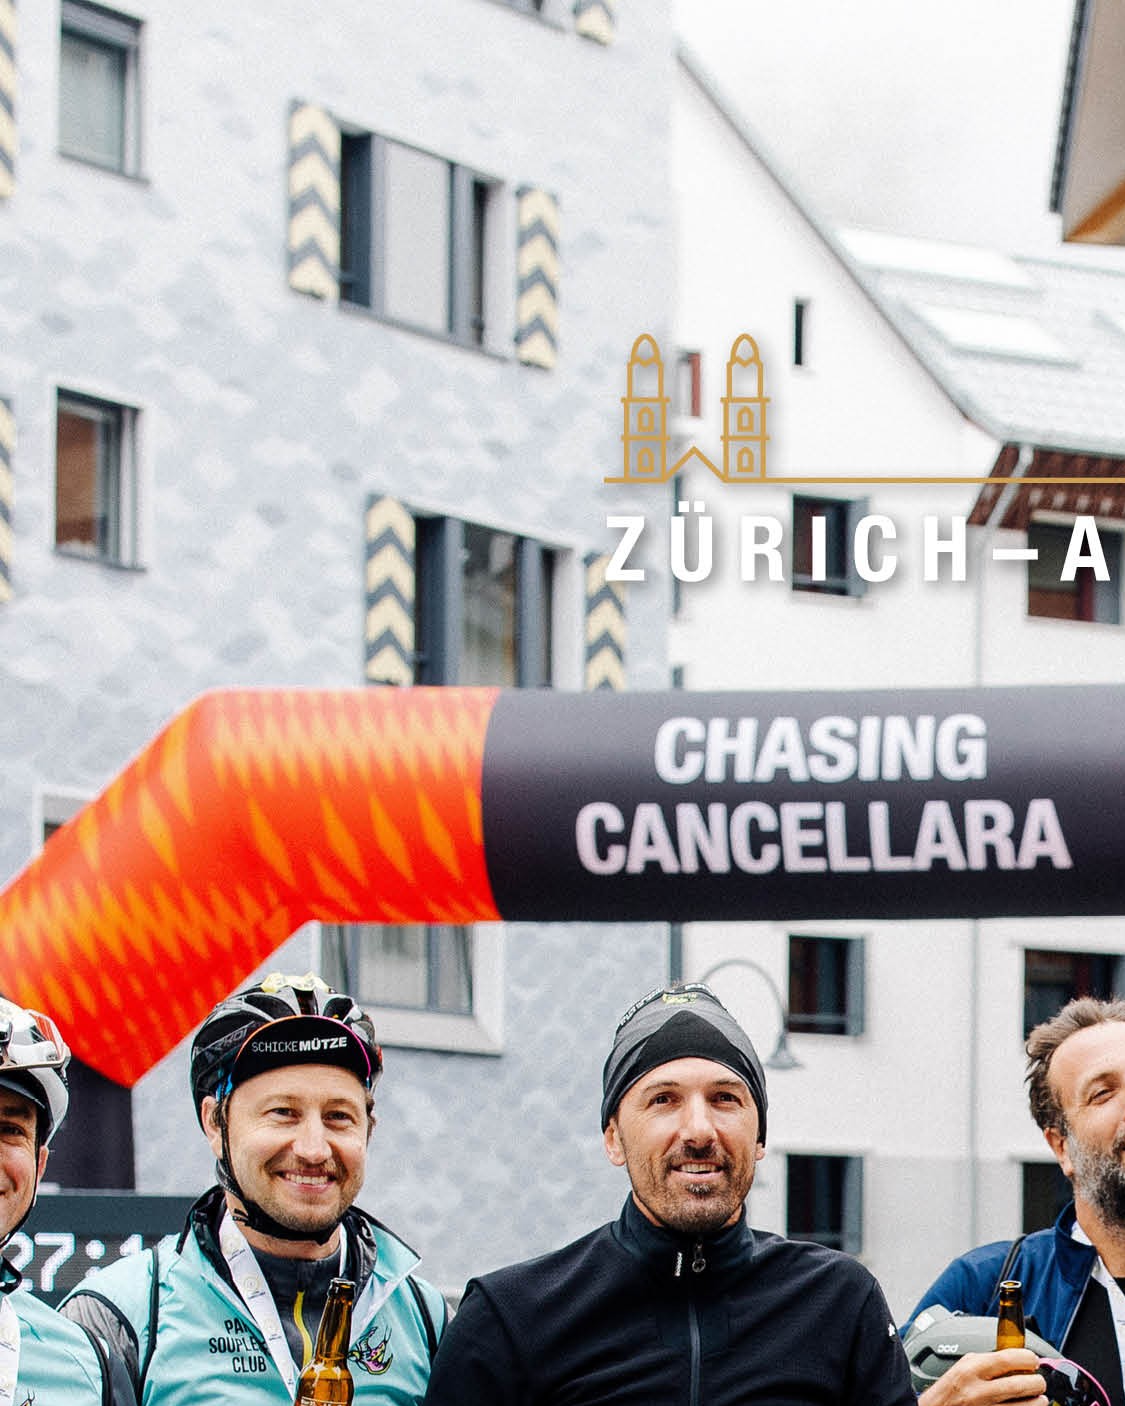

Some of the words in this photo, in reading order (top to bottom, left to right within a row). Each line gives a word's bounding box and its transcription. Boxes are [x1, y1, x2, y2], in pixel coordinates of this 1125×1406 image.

[654, 713, 987, 784] CHASING
[575, 798, 1073, 875] CANCELLARA
[232, 1355, 267, 1373] CLUB
